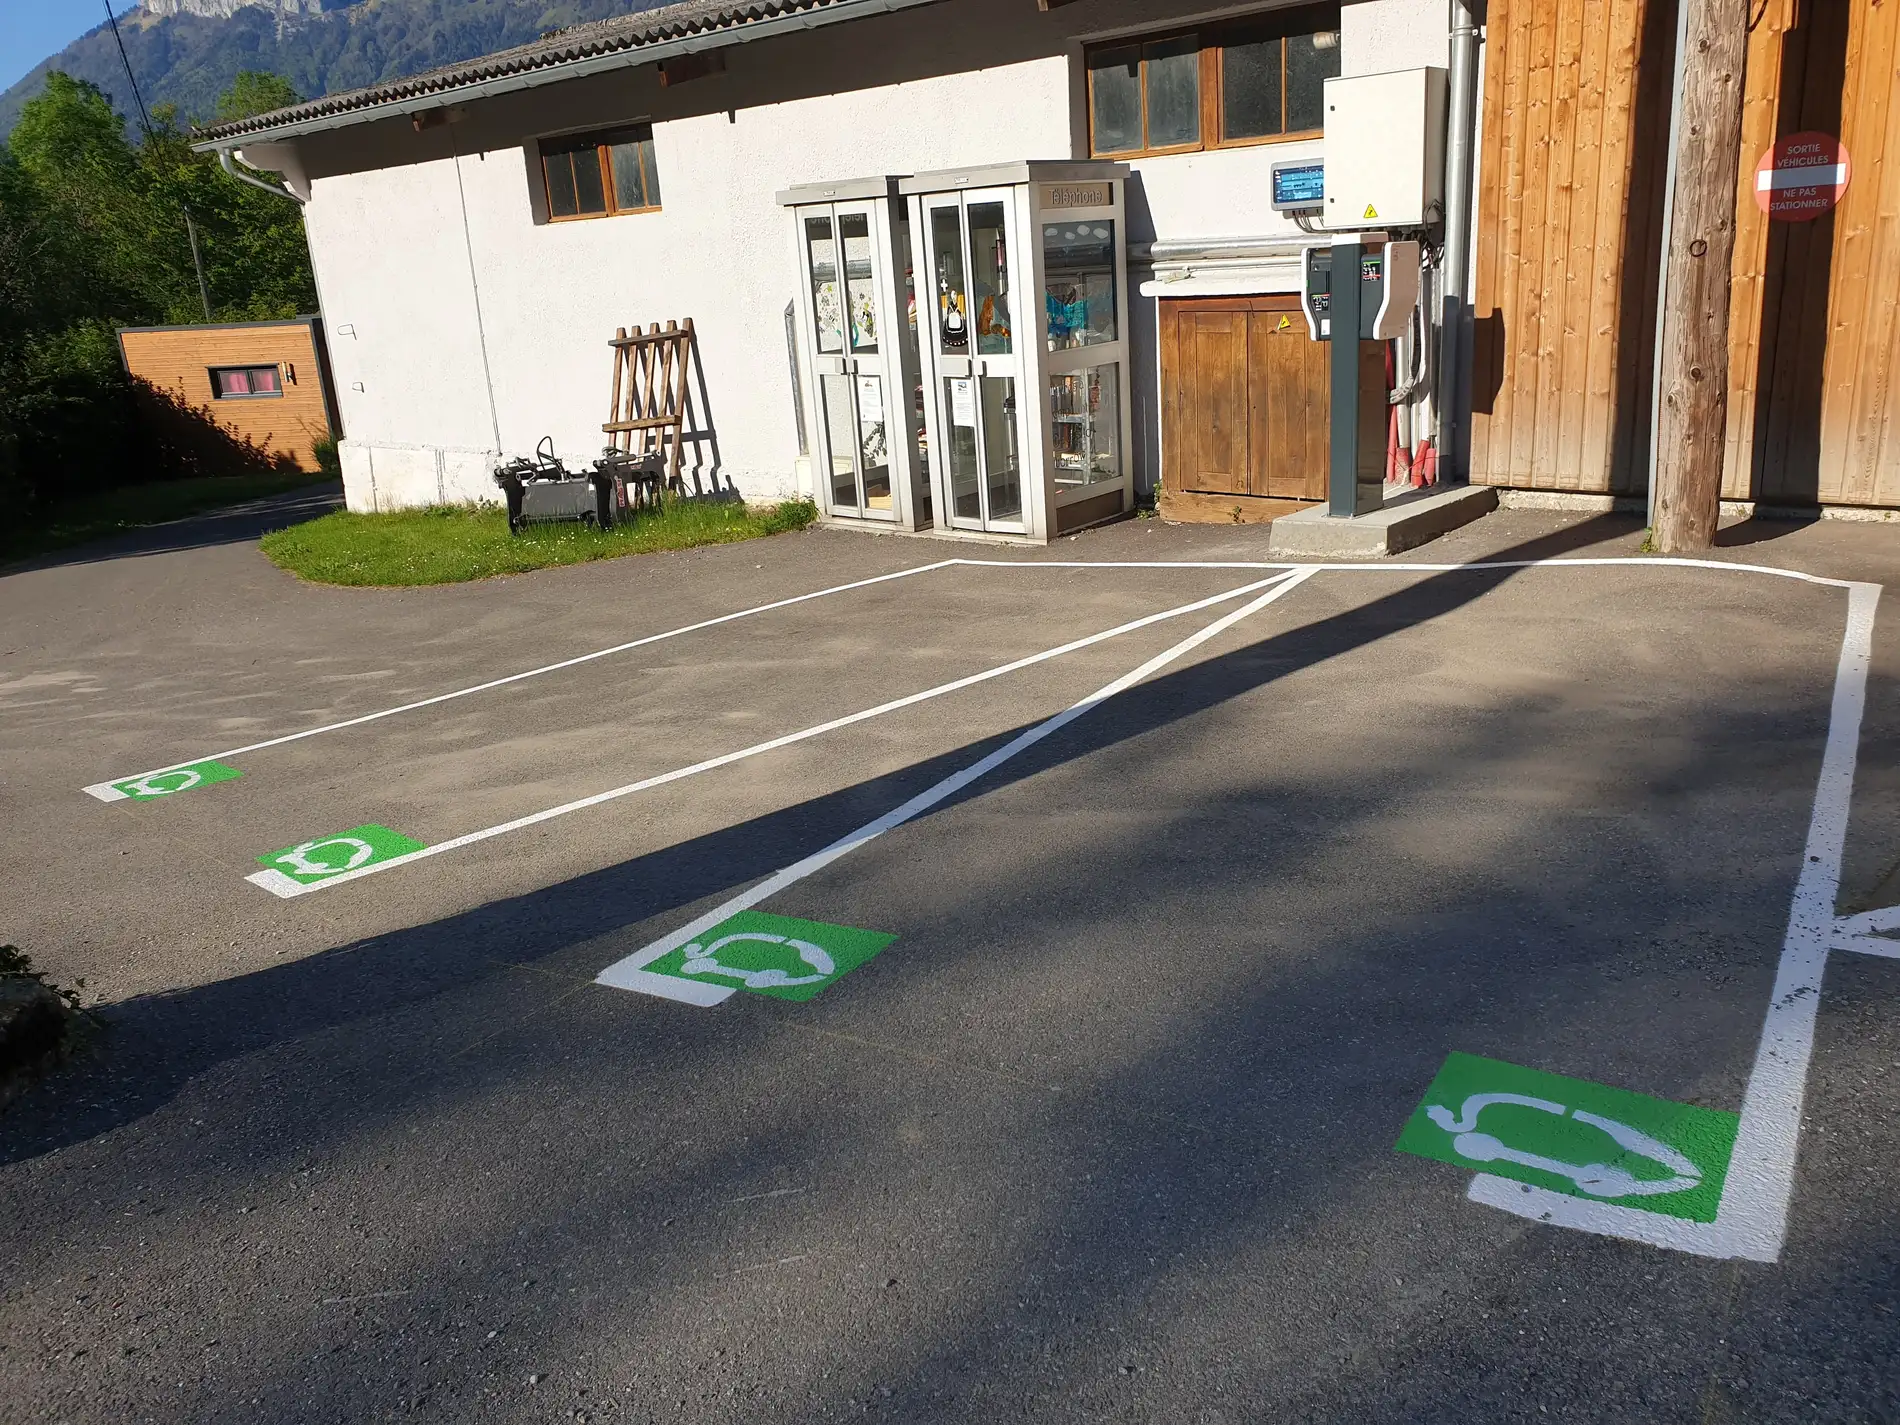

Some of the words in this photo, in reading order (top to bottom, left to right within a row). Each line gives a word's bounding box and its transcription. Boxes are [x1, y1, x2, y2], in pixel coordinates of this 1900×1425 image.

[1787, 144, 1820, 154] SORTIE
[1777, 155, 1828, 167] VÉHICULES
[1049, 188, 1102, 207] Téléphone
[1783, 188, 1796, 197] NE
[1799, 187, 1816, 196] PAS
[1770, 199, 1828, 210] STATIONNER
